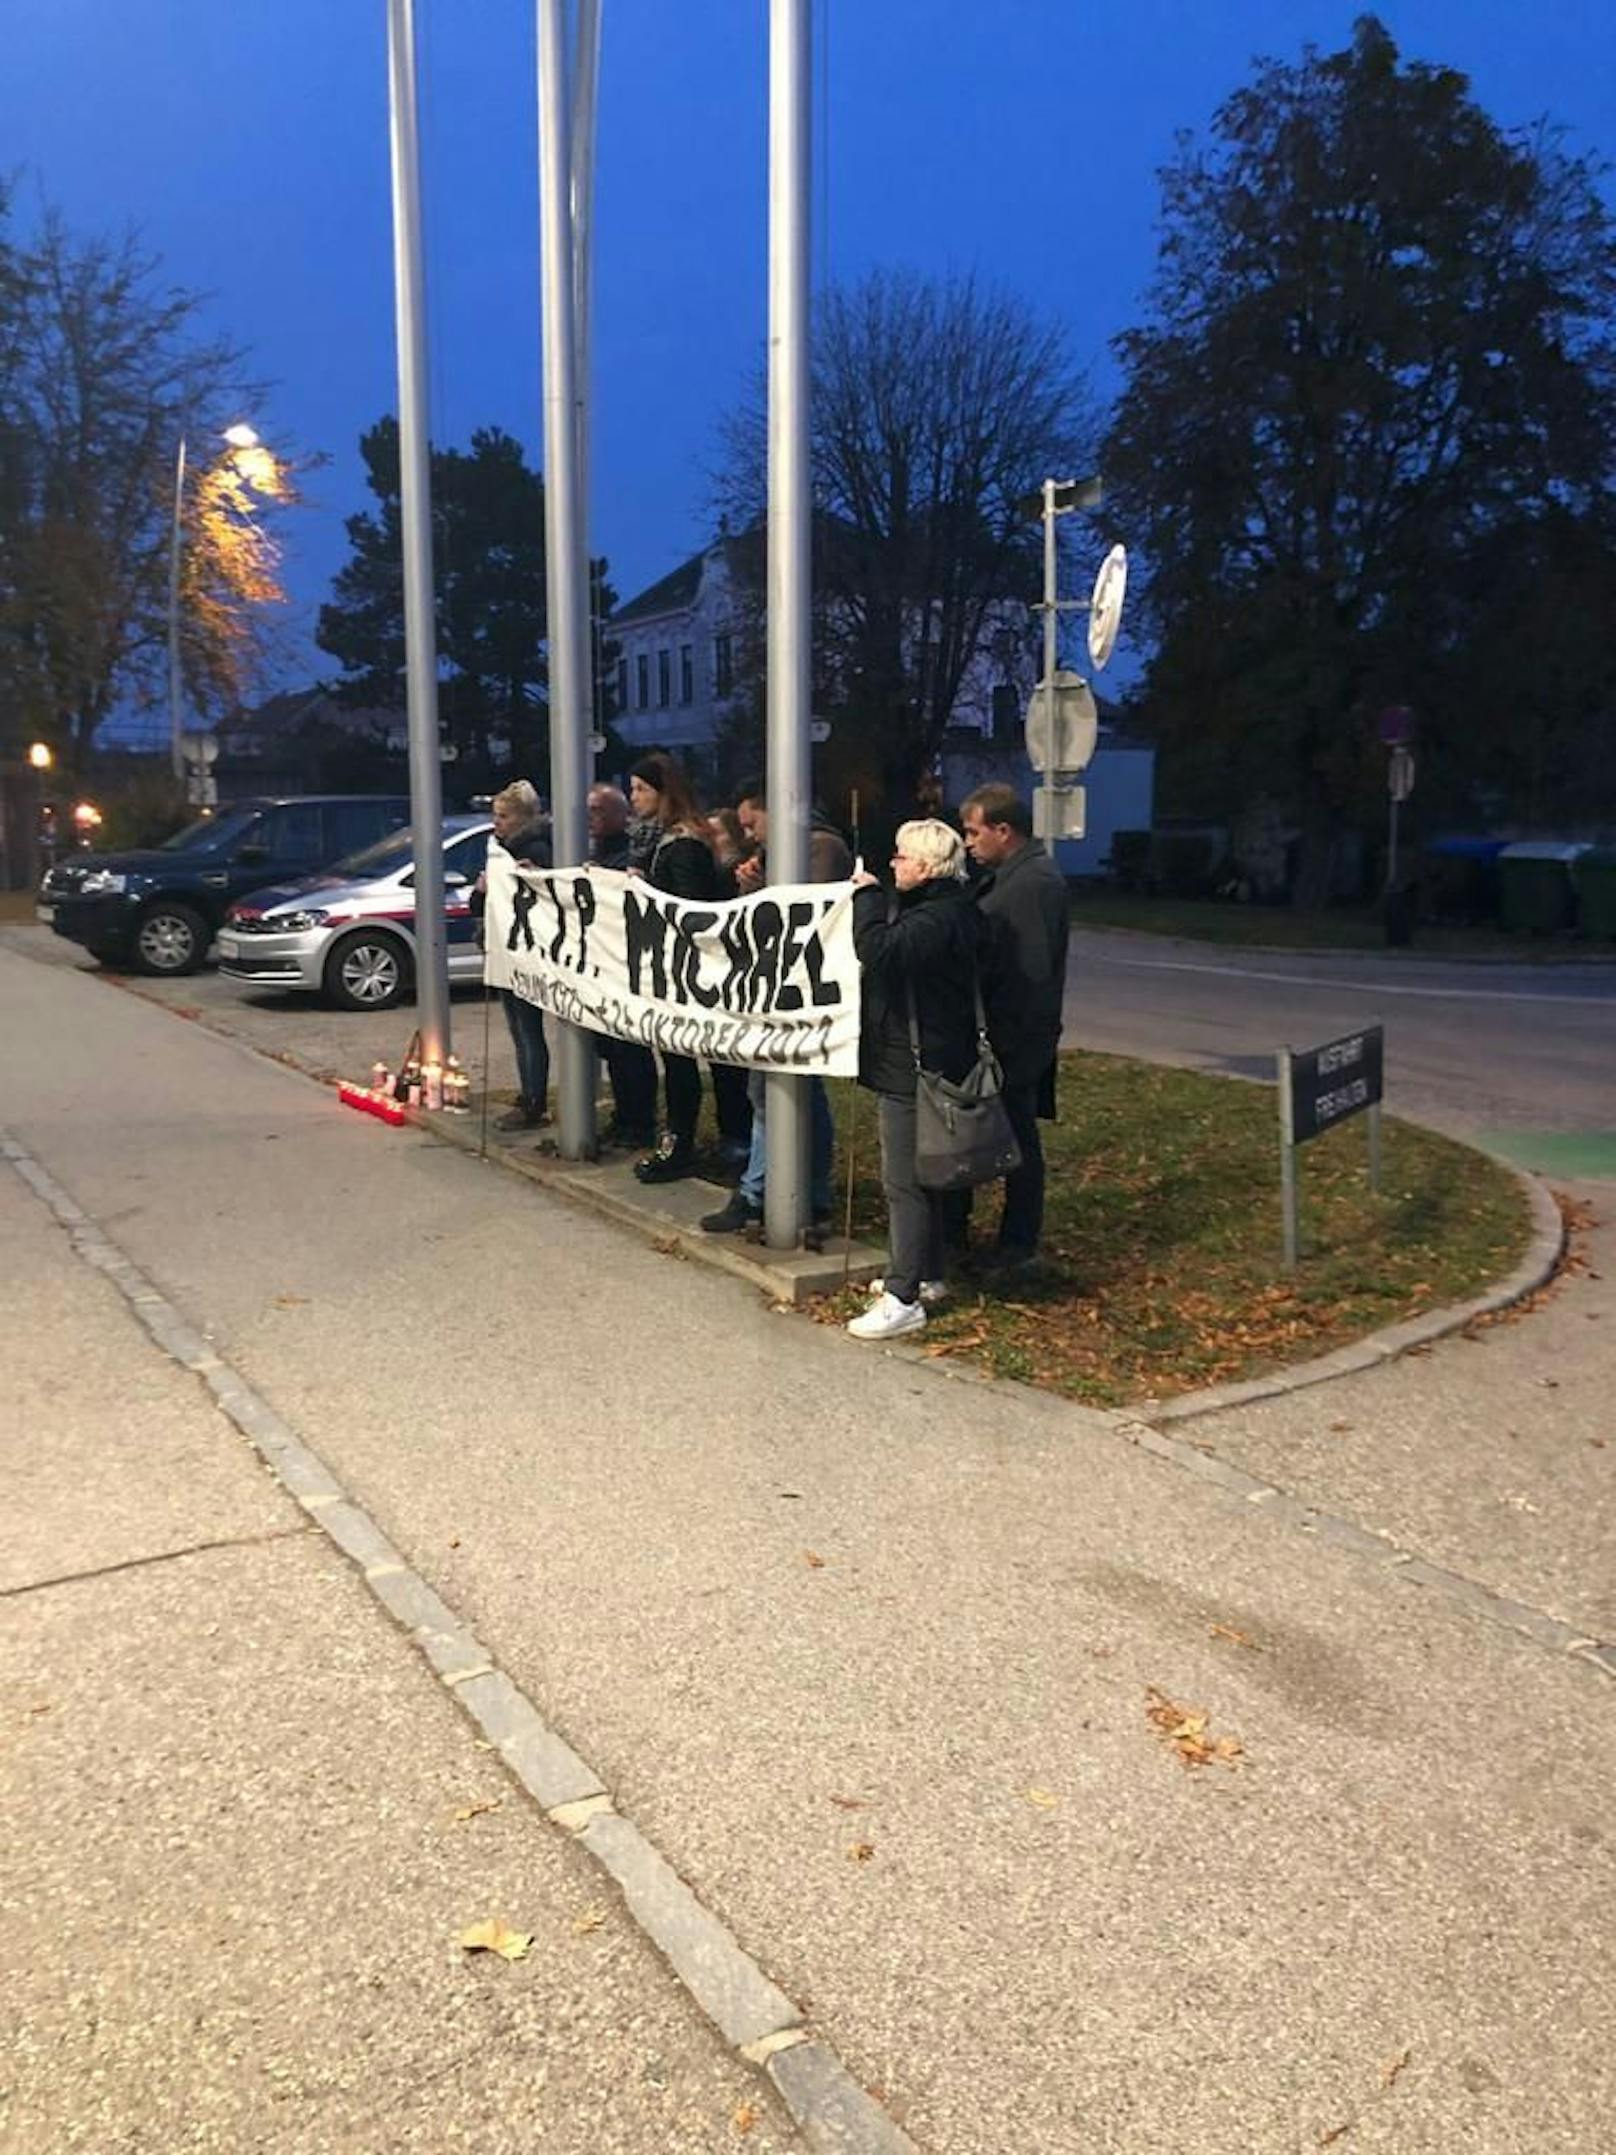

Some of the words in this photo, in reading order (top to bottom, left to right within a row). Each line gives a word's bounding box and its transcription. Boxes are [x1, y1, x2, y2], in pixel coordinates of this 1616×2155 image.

[507, 876, 600, 978] R.I.P.
[623, 889, 842, 1013] MICHAEL
[640, 1008, 749, 1062] OKTOBER
